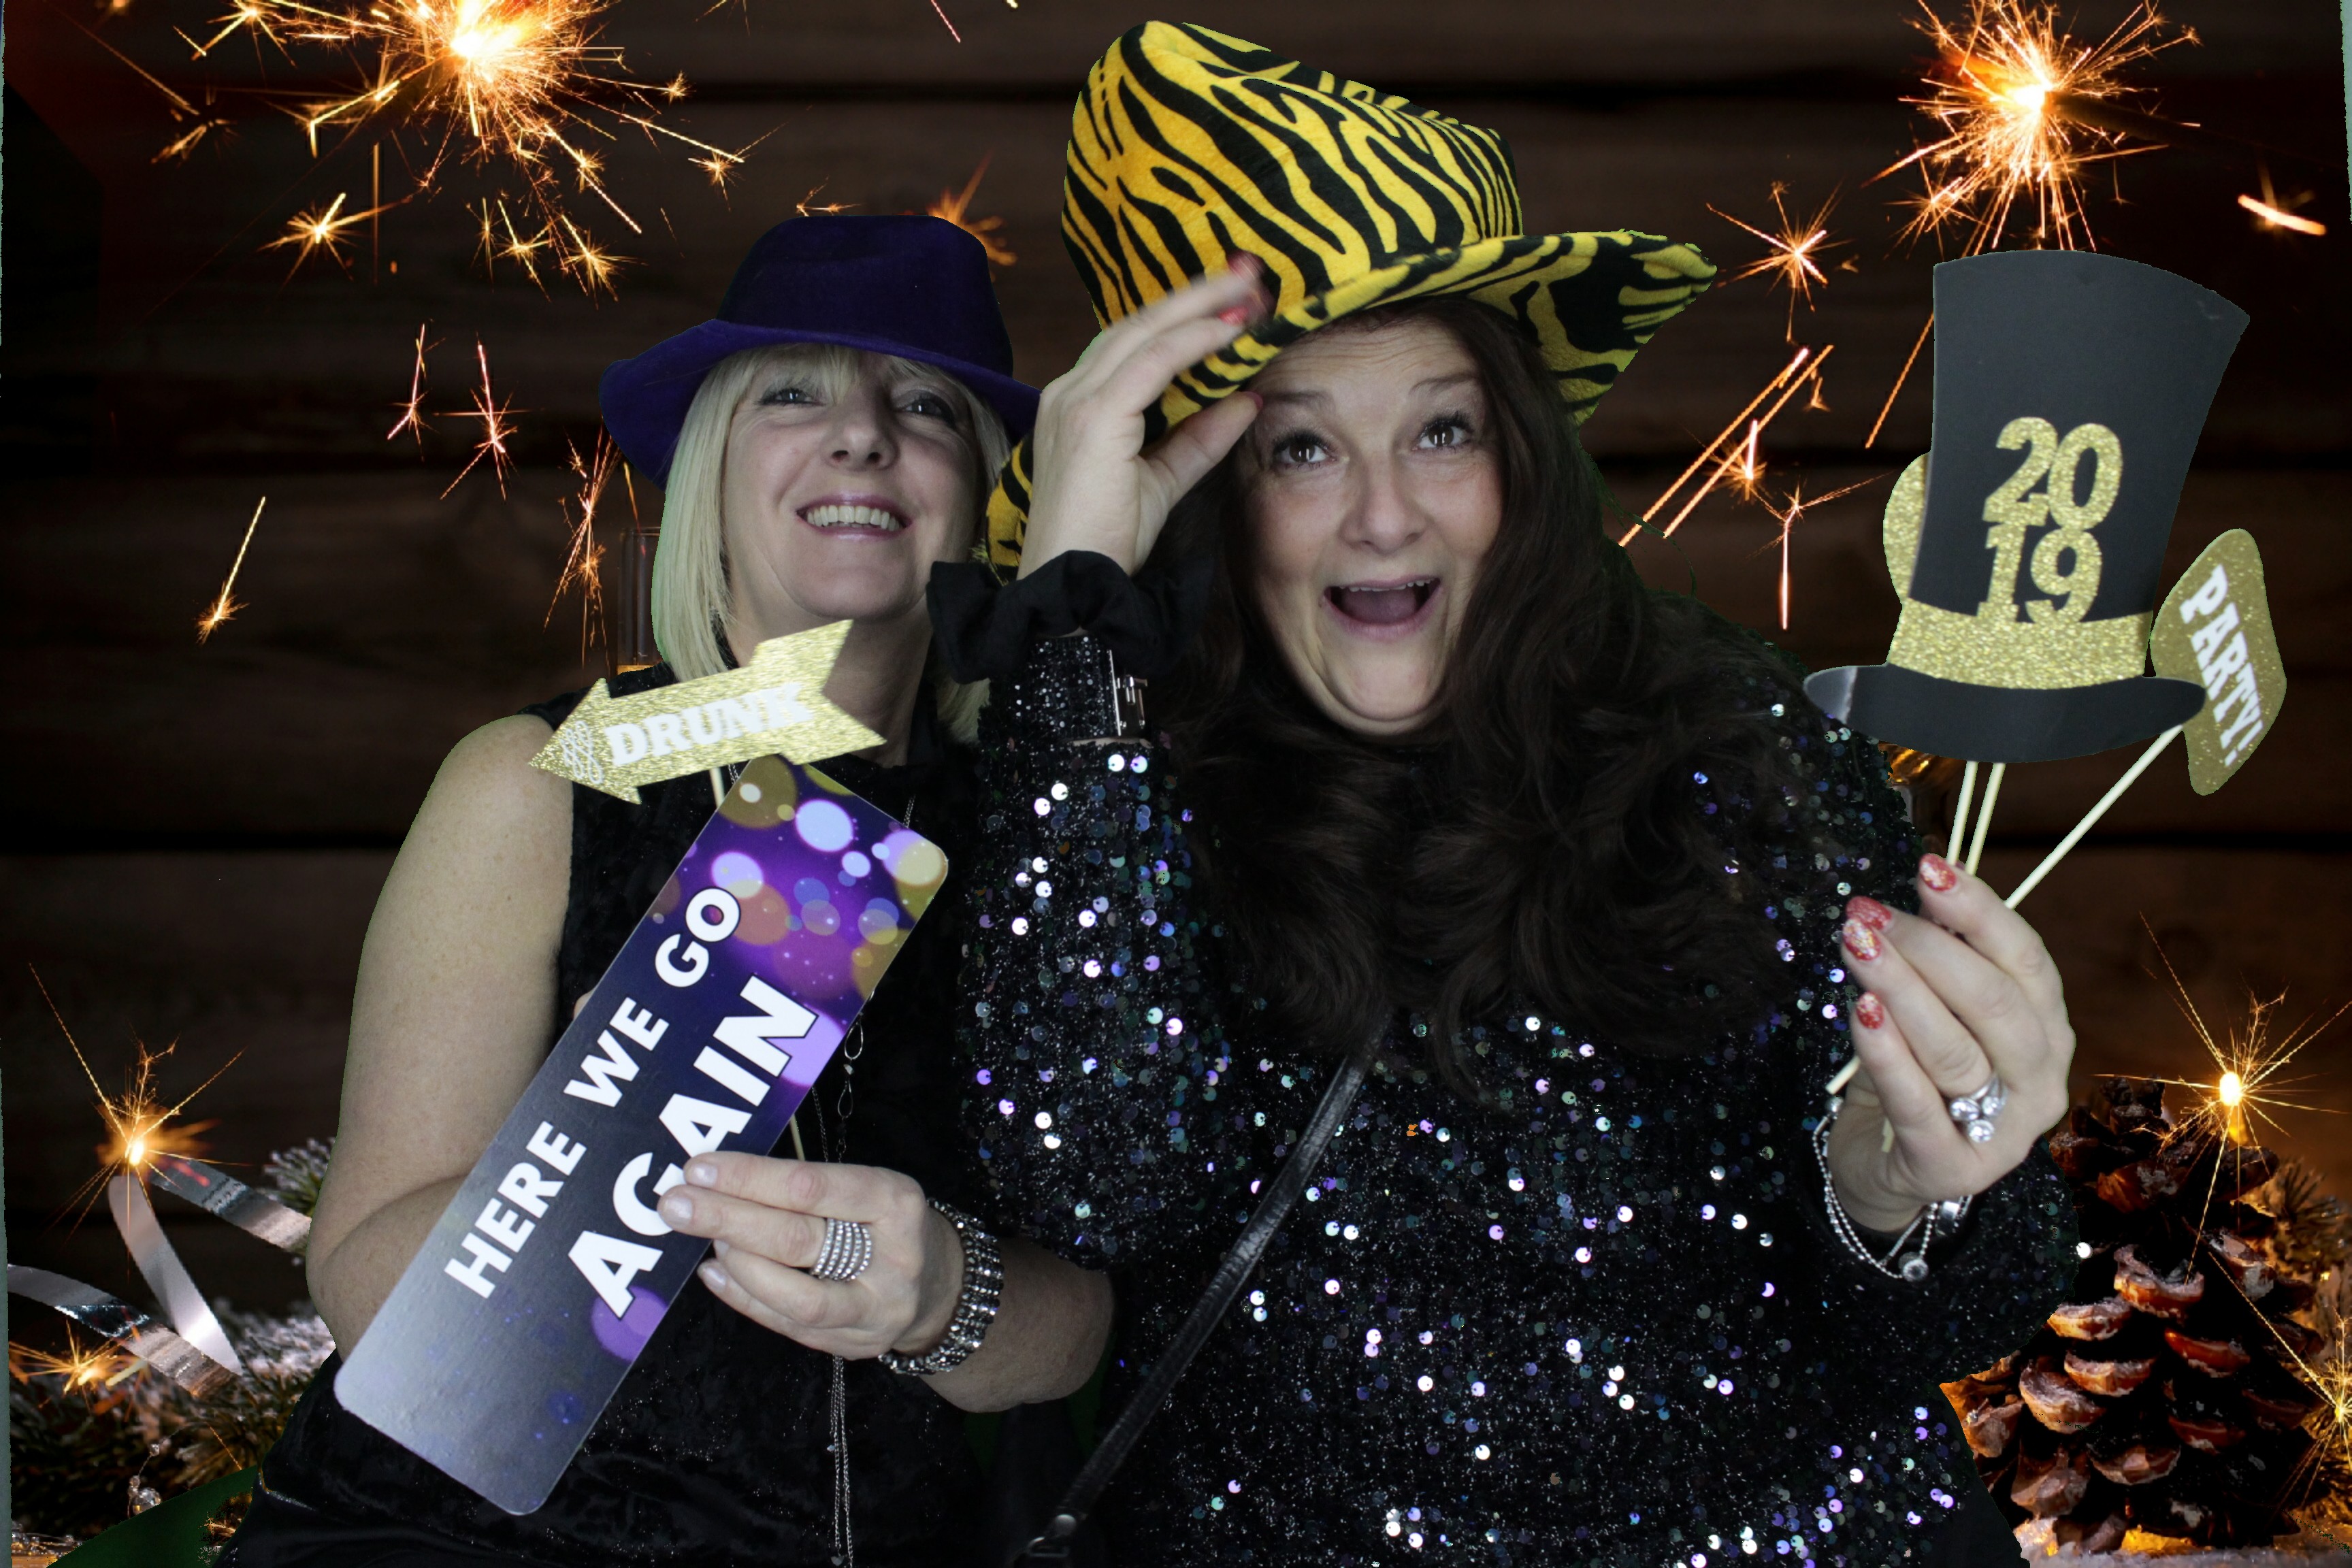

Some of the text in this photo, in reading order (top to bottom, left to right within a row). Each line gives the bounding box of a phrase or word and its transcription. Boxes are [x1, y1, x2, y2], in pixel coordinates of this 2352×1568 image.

[1982, 416, 2123, 530] 20
[1977, 523, 2104, 625] 19
[604, 682, 815, 766] DRUNK
[2179, 564, 2264, 768] PARTY!
[443, 887, 741, 1299] HERE WE GO
[567, 975, 820, 1319] AGAIN
